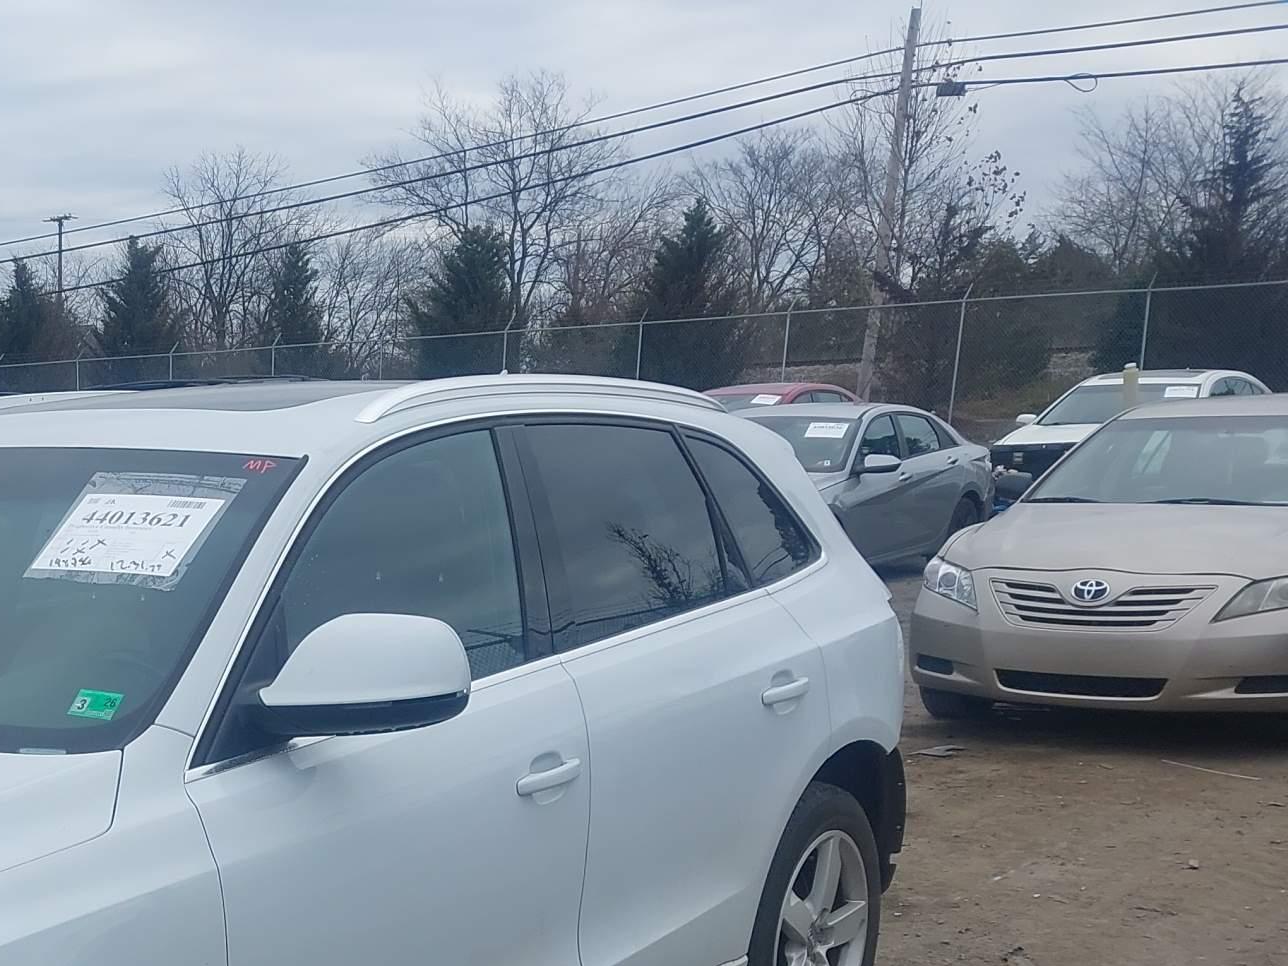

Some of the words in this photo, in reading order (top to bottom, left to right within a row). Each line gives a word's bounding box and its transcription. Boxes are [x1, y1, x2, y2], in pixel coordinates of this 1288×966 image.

[81, 510, 192, 528] 44013621
[76, 698, 88, 710] 3
[103, 696, 118, 709] 26
